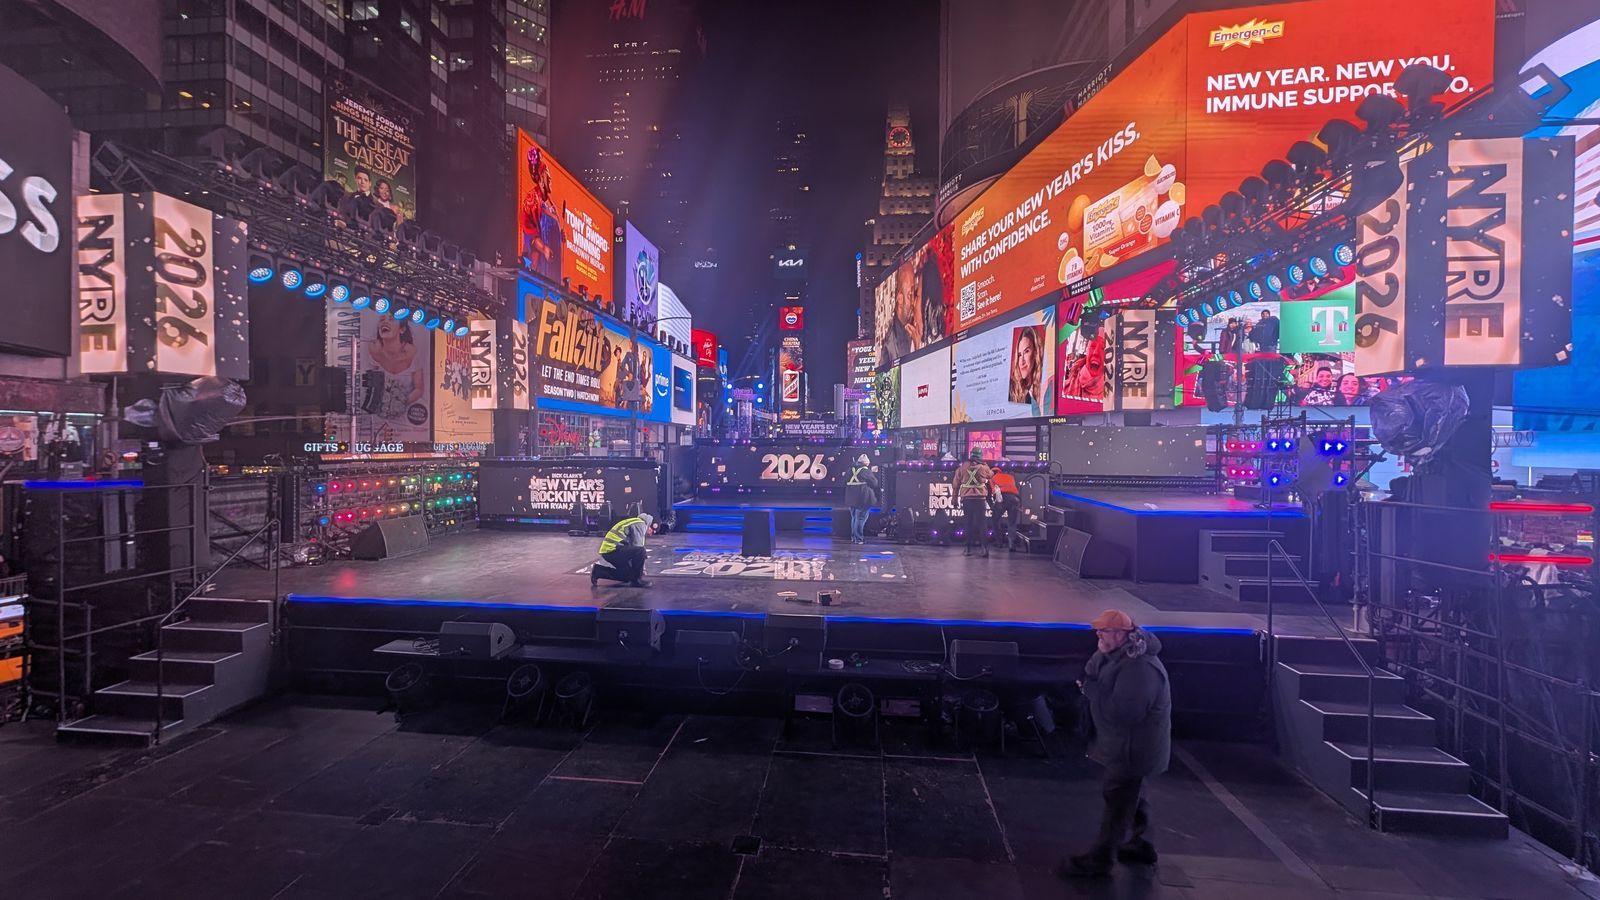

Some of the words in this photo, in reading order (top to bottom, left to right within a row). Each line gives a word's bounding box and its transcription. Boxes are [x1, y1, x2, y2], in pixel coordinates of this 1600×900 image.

[1213, 24, 1280, 43] Emergen-C
[1078, 63, 1113, 99] MARRIOTT
[1207, 71, 1261, 91] NEW
[1265, 67, 1330, 86] YEAR.
[1336, 59, 1393, 80] NEW
[1078, 77, 1108, 108] MARQUIS
[1206, 89, 1298, 113] IMMUNE
[1303, 83, 1408, 106] SUPPOR
[336, 101, 360, 118] SINGS
[362, 113, 374, 125] HIS
[375, 121, 393, 136] FACE
[395, 131, 410, 144] OFF!
[376, 112, 404, 133] JORDAN
[334, 116, 362, 145] THE
[364, 133, 411, 166] GREAT
[344, 140, 402, 176] GATSBY
[940, 174, 962, 195] MARRIOTT
[960, 238, 987, 261] SHARE
[987, 210, 1015, 243] YOUR
[1016, 188, 1045, 222] NEW
[1045, 153, 1094, 200] YEAR'S
[1097, 122, 1140, 166] KISS.
[565, 208, 585, 234] TONY
[1089, 226, 1111, 240] Vitamin
[1155, 212, 1175, 226] VITAMIN
[573, 229, 601, 261] WINNING
[960, 255, 982, 278] WITH
[983, 209, 1052, 266] CONFIDENCE.
[1446, 163, 1508, 339] NYRE
[77, 214, 117, 353] NYRE
[155, 216, 209, 348] 2026
[1066, 269, 1083, 280] VITAMINS
[1071, 277, 1094, 291] MARRIOTT
[1355, 198, 1401, 349] 2026
[977, 301, 986, 310] See
[990, 291, 1002, 304] here!
[1071, 284, 1092, 296] MARQUIS
[537, 300, 602, 371] Fallout
[470, 330, 493, 399] NYRE
[512, 334, 527, 398] 2026
[1121, 319, 1150, 399] NYRE
[542, 364, 551, 379] LET
[554, 367, 563, 381] THE
[564, 370, 574, 384] END
[576, 372, 590, 387] TIMES
[655, 373, 669, 387] prime
[543, 385, 564, 398] SEASON
[564, 387, 575, 399] TWO
[304, 442, 339, 452] GIFTS
[433, 443, 453, 451] GIFTS
[973, 440, 997, 449] PANDORA
[760, 453, 828, 481] 2026
[530, 478, 562, 491] NEW
[563, 478, 605, 491] YEAR'S
[530, 491, 579, 503] ROCKIN'
[581, 491, 605, 503] EVE
